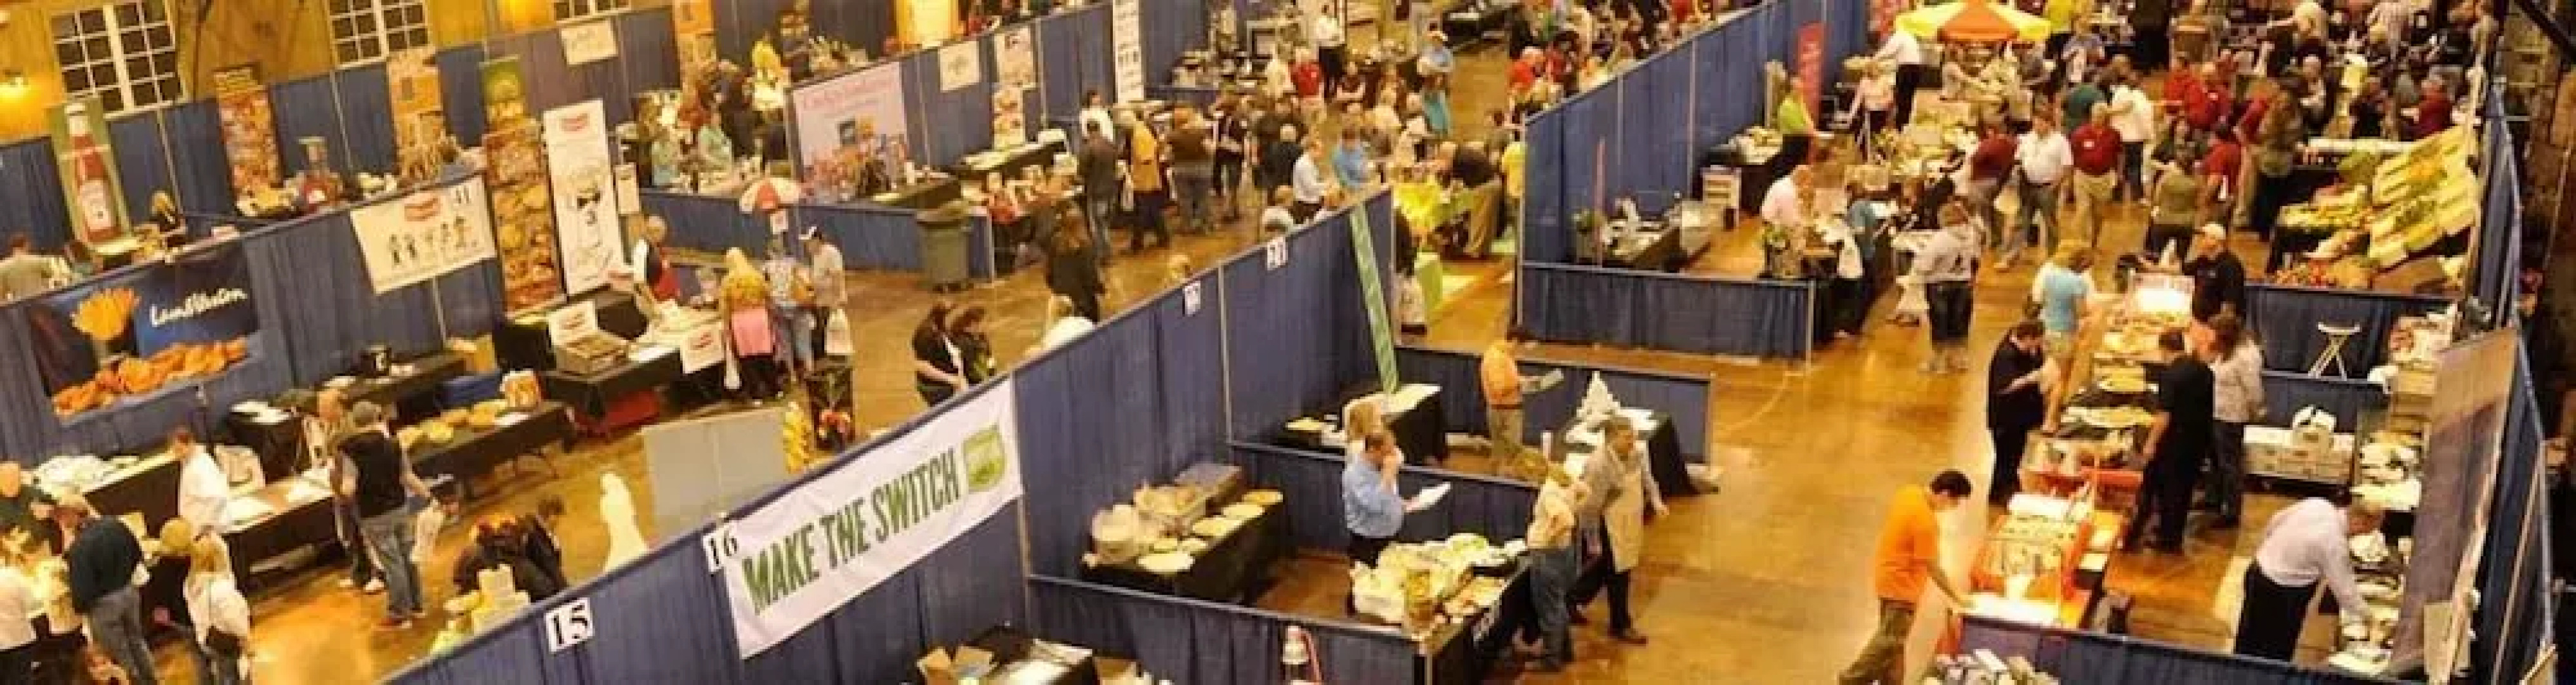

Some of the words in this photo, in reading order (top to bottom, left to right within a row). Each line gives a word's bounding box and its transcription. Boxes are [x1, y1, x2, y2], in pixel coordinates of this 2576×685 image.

[707, 530, 739, 567] 16
[741, 521, 820, 616] MAKE
[818, 497, 870, 569] THE
[871, 447, 961, 543] SWITCH
[553, 603, 589, 647] 15
